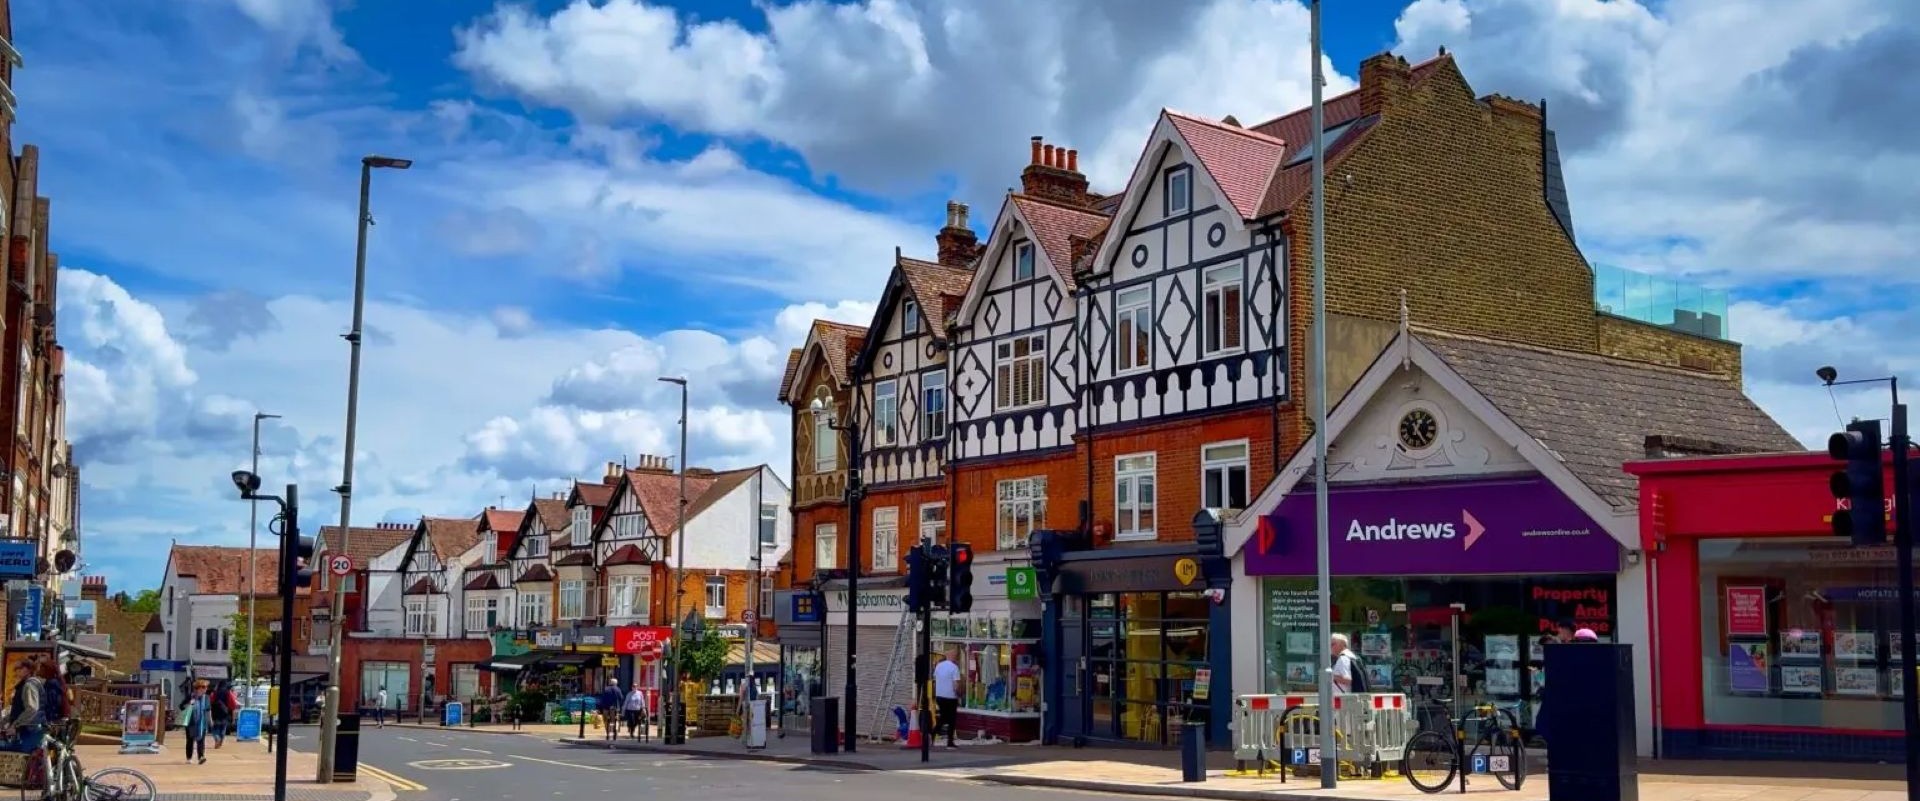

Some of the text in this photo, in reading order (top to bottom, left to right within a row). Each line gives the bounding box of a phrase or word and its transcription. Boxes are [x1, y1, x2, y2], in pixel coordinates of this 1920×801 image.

[1346, 518, 1456, 541] Andrews
[333, 560, 349, 570] 20
[1533, 586, 1608, 603] Property
[1575, 603, 1608, 617] And
[1539, 618, 1609, 632] Puose
[633, 631, 657, 640] POST
[1294, 750, 1303, 763] P
[1475, 758, 1484, 771] P
